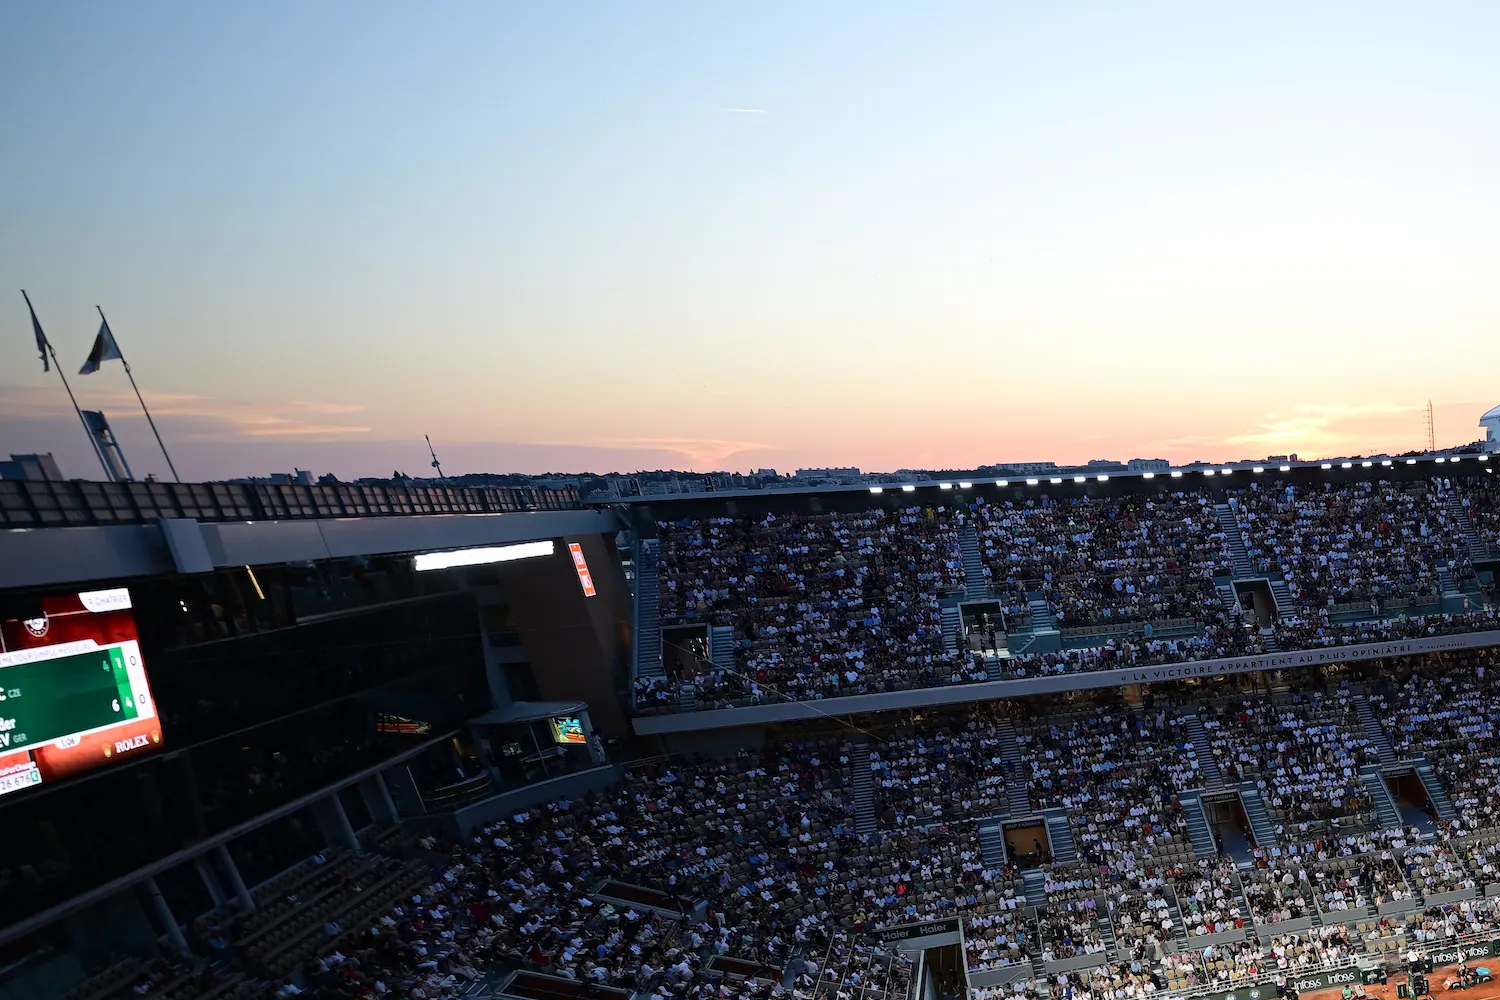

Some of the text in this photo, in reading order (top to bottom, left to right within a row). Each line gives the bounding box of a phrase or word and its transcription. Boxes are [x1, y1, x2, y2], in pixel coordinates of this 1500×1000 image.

[103, 660, 110, 672] 4
[115, 657, 122, 669] 1
[130, 656, 136, 666] 0
[1133, 673, 1147, 681] LA
[1154, 665, 1212, 678] VICTOIRE
[1220, 657, 1292, 671] APPARTIENT
[1299, 655, 1313, 663] AU
[1320, 652, 1346, 661] PLUS
[1352, 644, 1412, 657] OPINIÂTRE
[8, 688, 21, 699] CZE
[139, 694, 146, 704] 0
[112, 699, 120, 712] 6
[126, 696, 133, 708] 4
[13, 733, 28, 744] GER
[115, 734, 149, 754] ROLEX
[15, 774, 31, 786] 676
[920, 923, 946, 934] Haier
[881, 930, 909, 940] Haier
[1464, 946, 1489, 957] nfosys
[1327, 972, 1355, 984] Infosys
